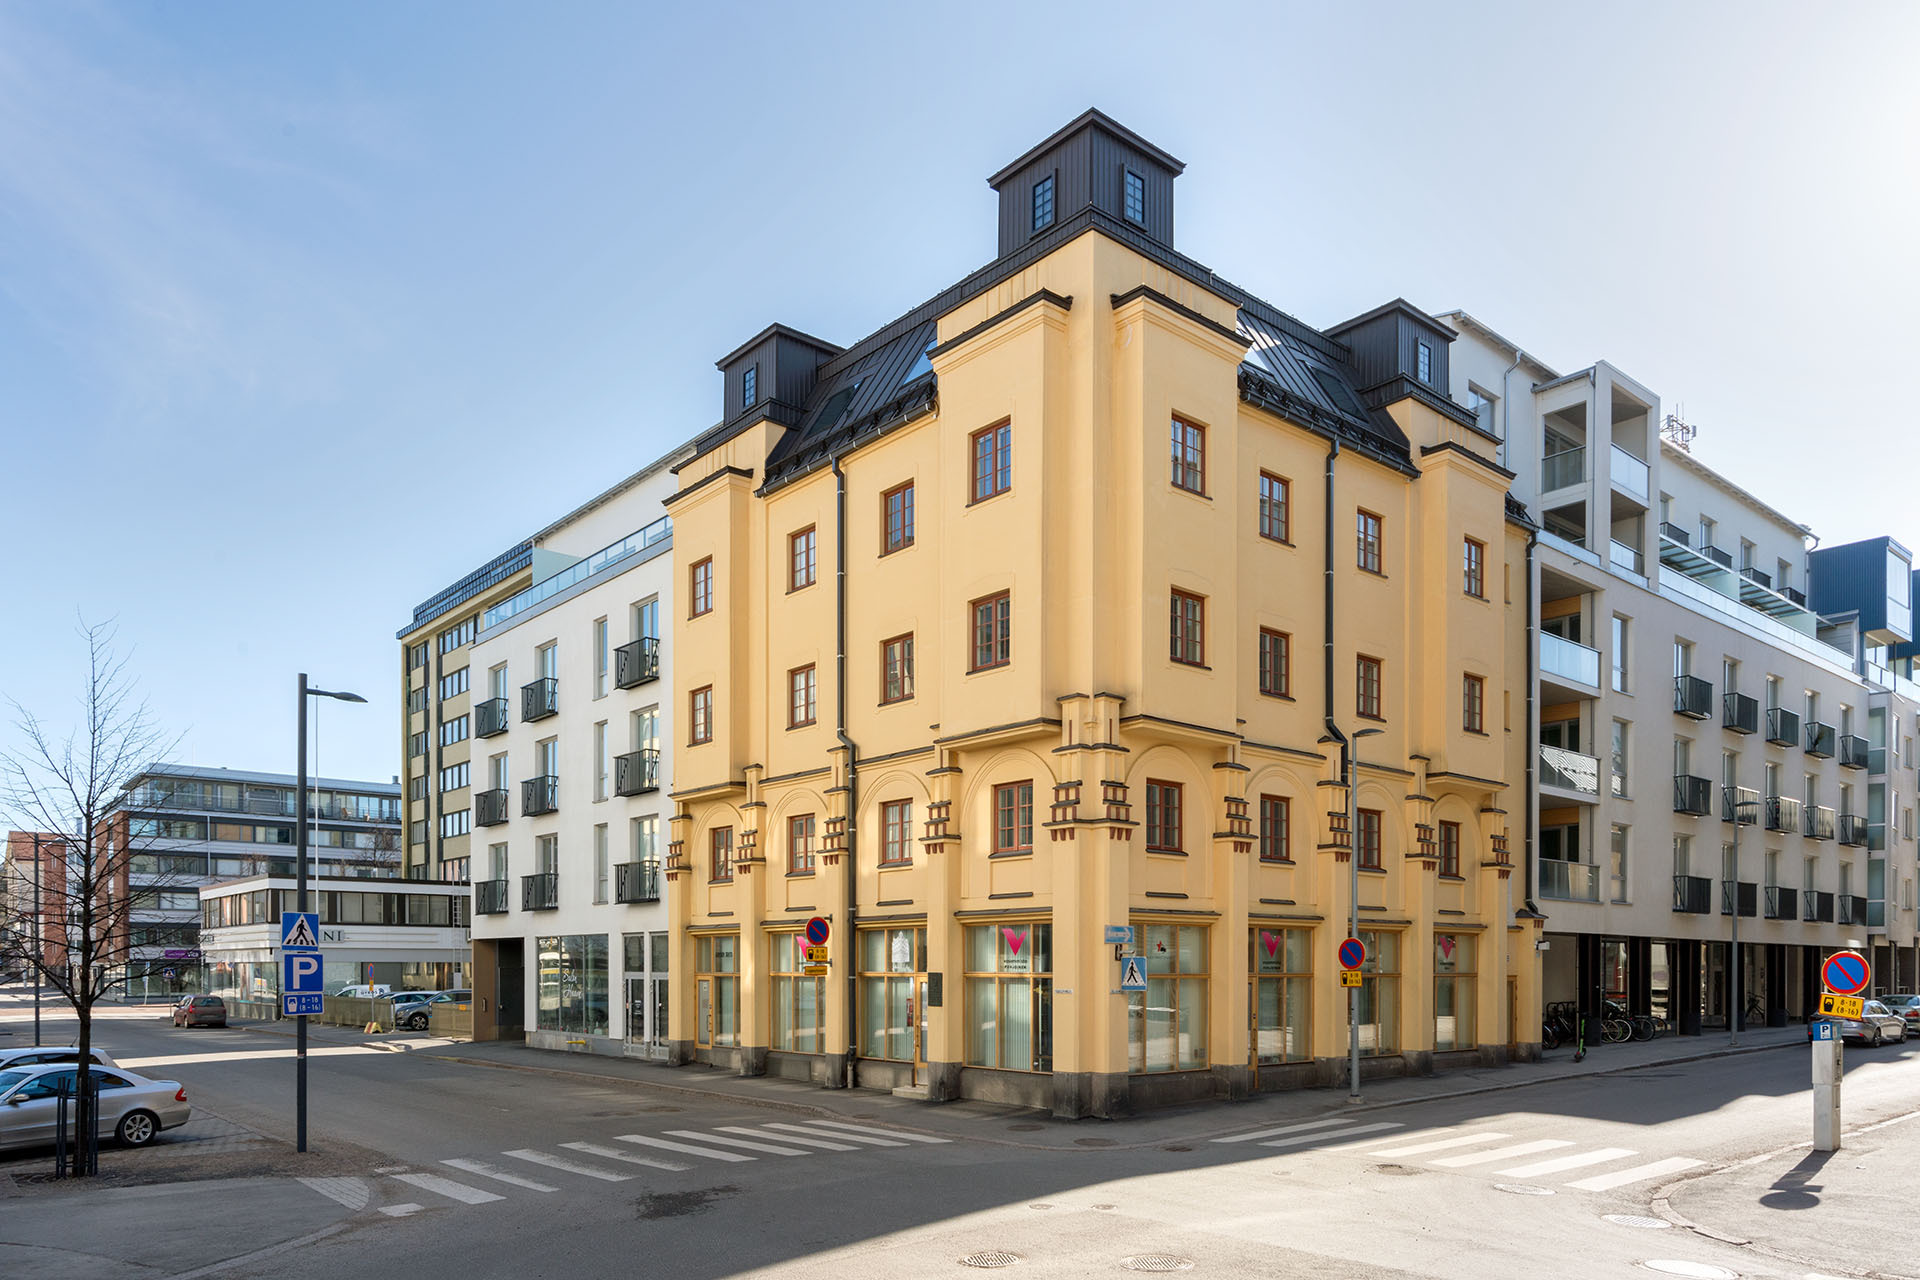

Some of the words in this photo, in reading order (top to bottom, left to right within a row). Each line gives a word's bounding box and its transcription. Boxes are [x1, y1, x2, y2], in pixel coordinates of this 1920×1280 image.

[292, 957, 318, 990] P
[1840, 999, 1857, 1007] 8-18
[1836, 1005, 1859, 1016] (8-16)
